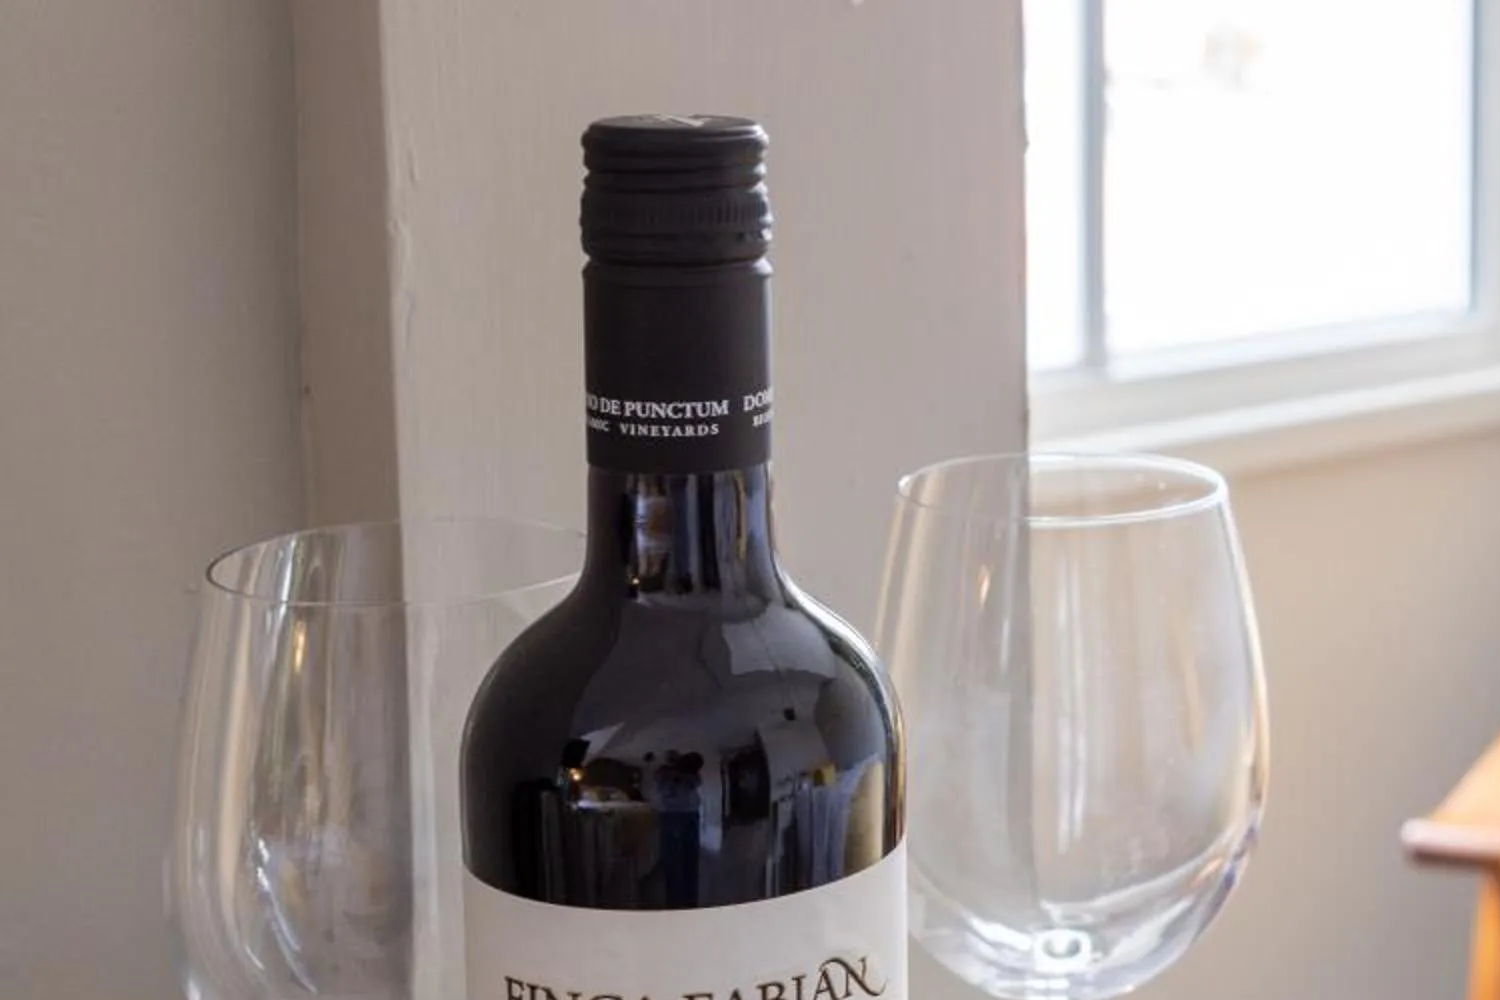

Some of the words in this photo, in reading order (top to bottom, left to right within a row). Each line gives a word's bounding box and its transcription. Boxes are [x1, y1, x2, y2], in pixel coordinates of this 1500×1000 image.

[600, 396, 622, 415] DE
[624, 400, 730, 419] PUNCTUM
[619, 422, 720, 438] VINEYARDS
